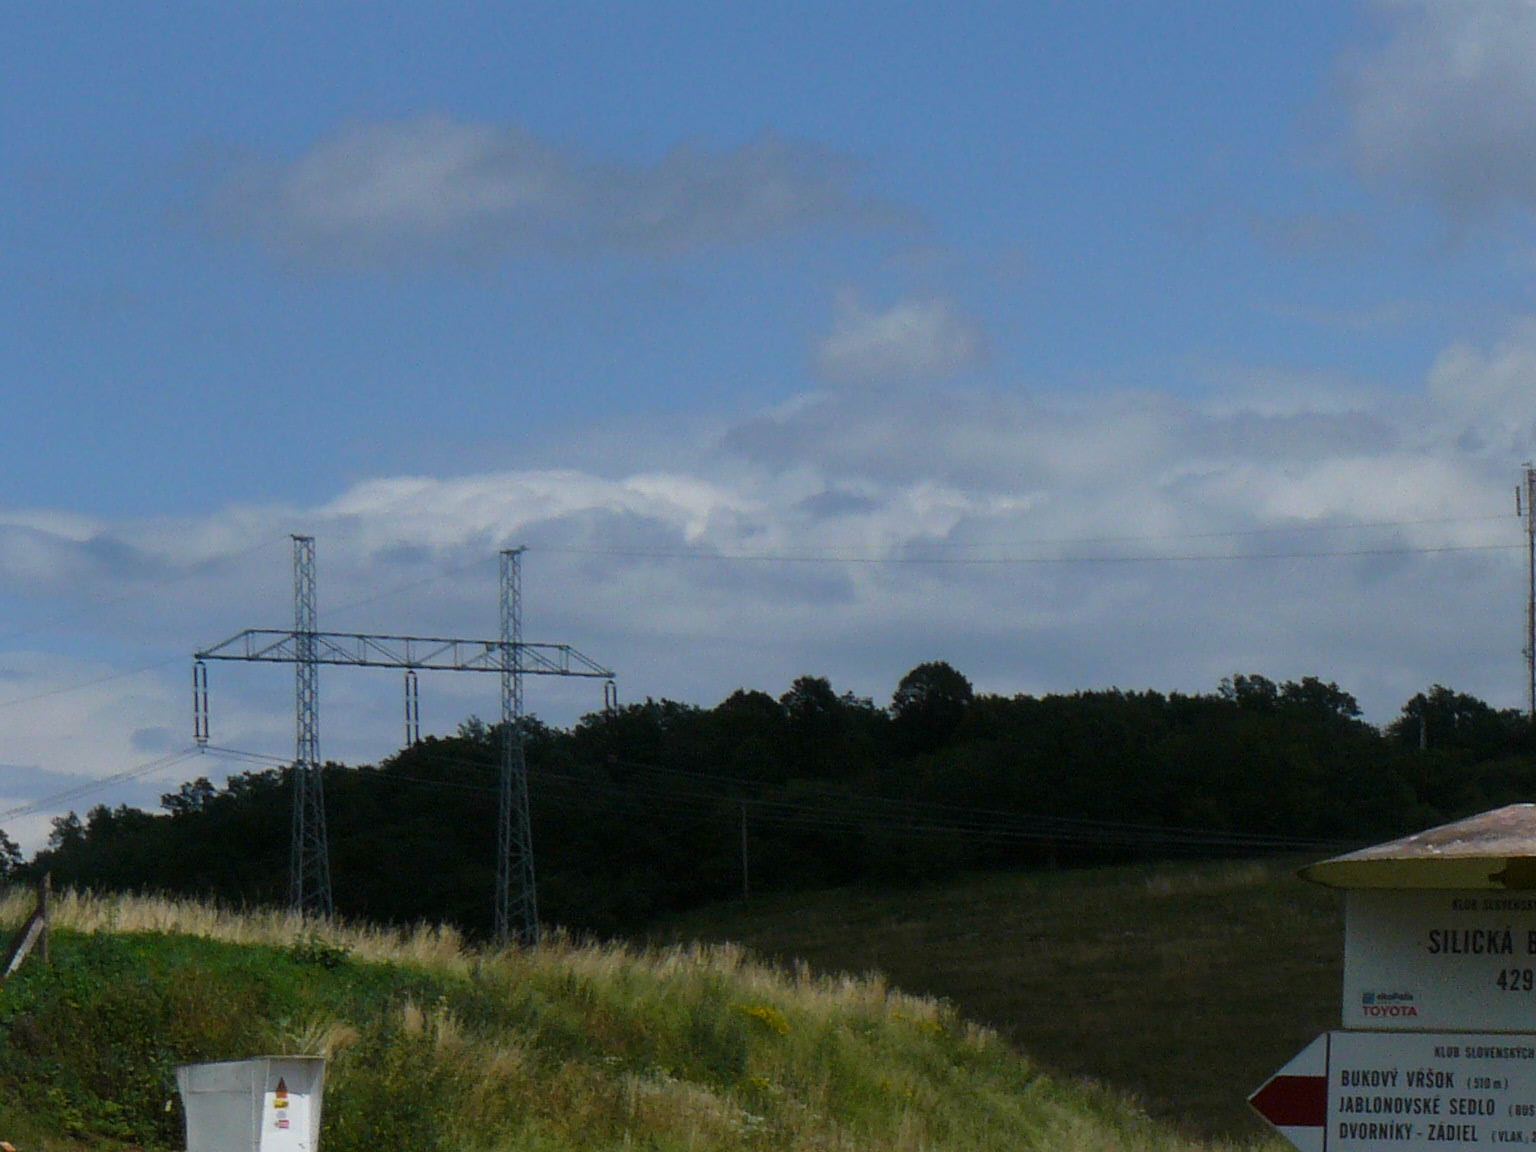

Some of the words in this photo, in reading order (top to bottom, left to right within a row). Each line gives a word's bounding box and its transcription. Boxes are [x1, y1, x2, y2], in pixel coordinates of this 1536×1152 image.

[1428, 927, 1513, 955] SILICKÁ
[1496, 968, 1534, 991] 429
[1362, 1006, 1418, 1017] TOYOTA
[1434, 1046, 1460, 1058] KLUB
[1341, 1068, 1398, 1088] BUKOVÝ
[1339, 1094, 1440, 1115] JABLONOVSKÉ
[1449, 1098, 1496, 1116] SEDLO
[1339, 1120, 1413, 1140] DVORNÍKY
[1427, 1120, 1479, 1142] ZÁDIEL
